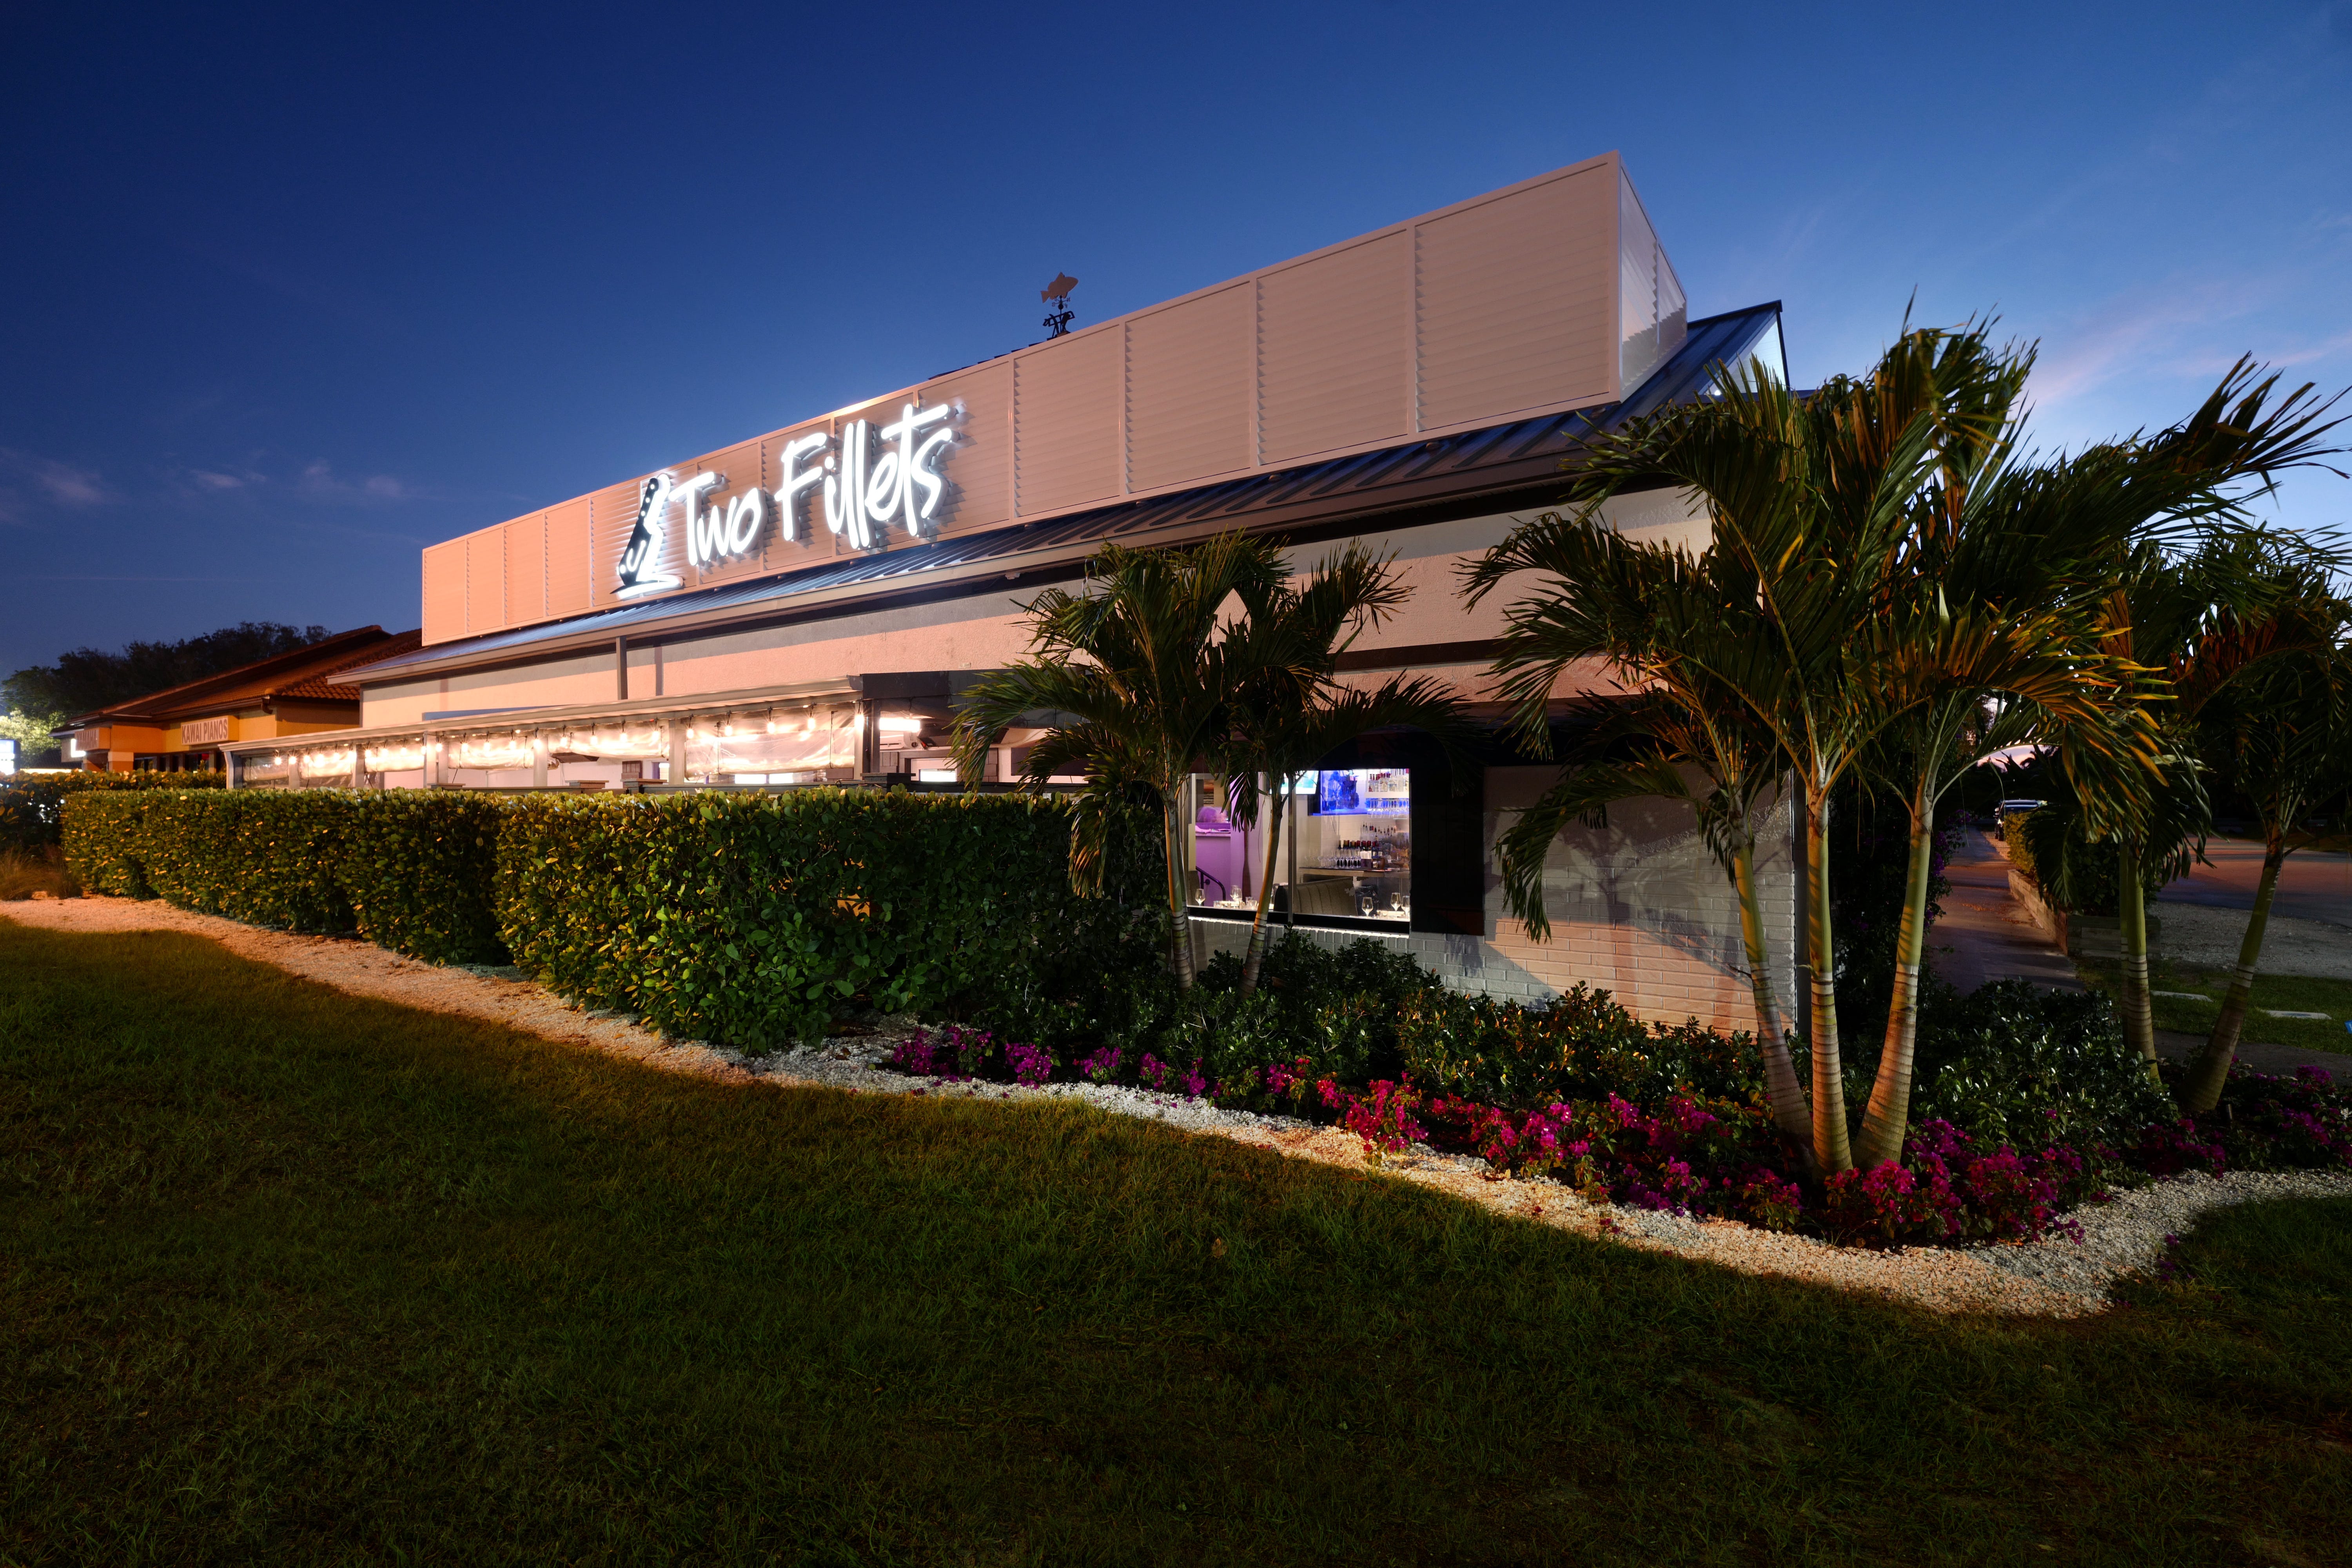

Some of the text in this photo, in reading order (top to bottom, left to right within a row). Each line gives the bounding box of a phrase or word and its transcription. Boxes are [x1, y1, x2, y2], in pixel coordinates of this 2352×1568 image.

[668, 403, 956, 566] Two Fillets
[182, 719, 227, 744] KAWAI PIANOS
